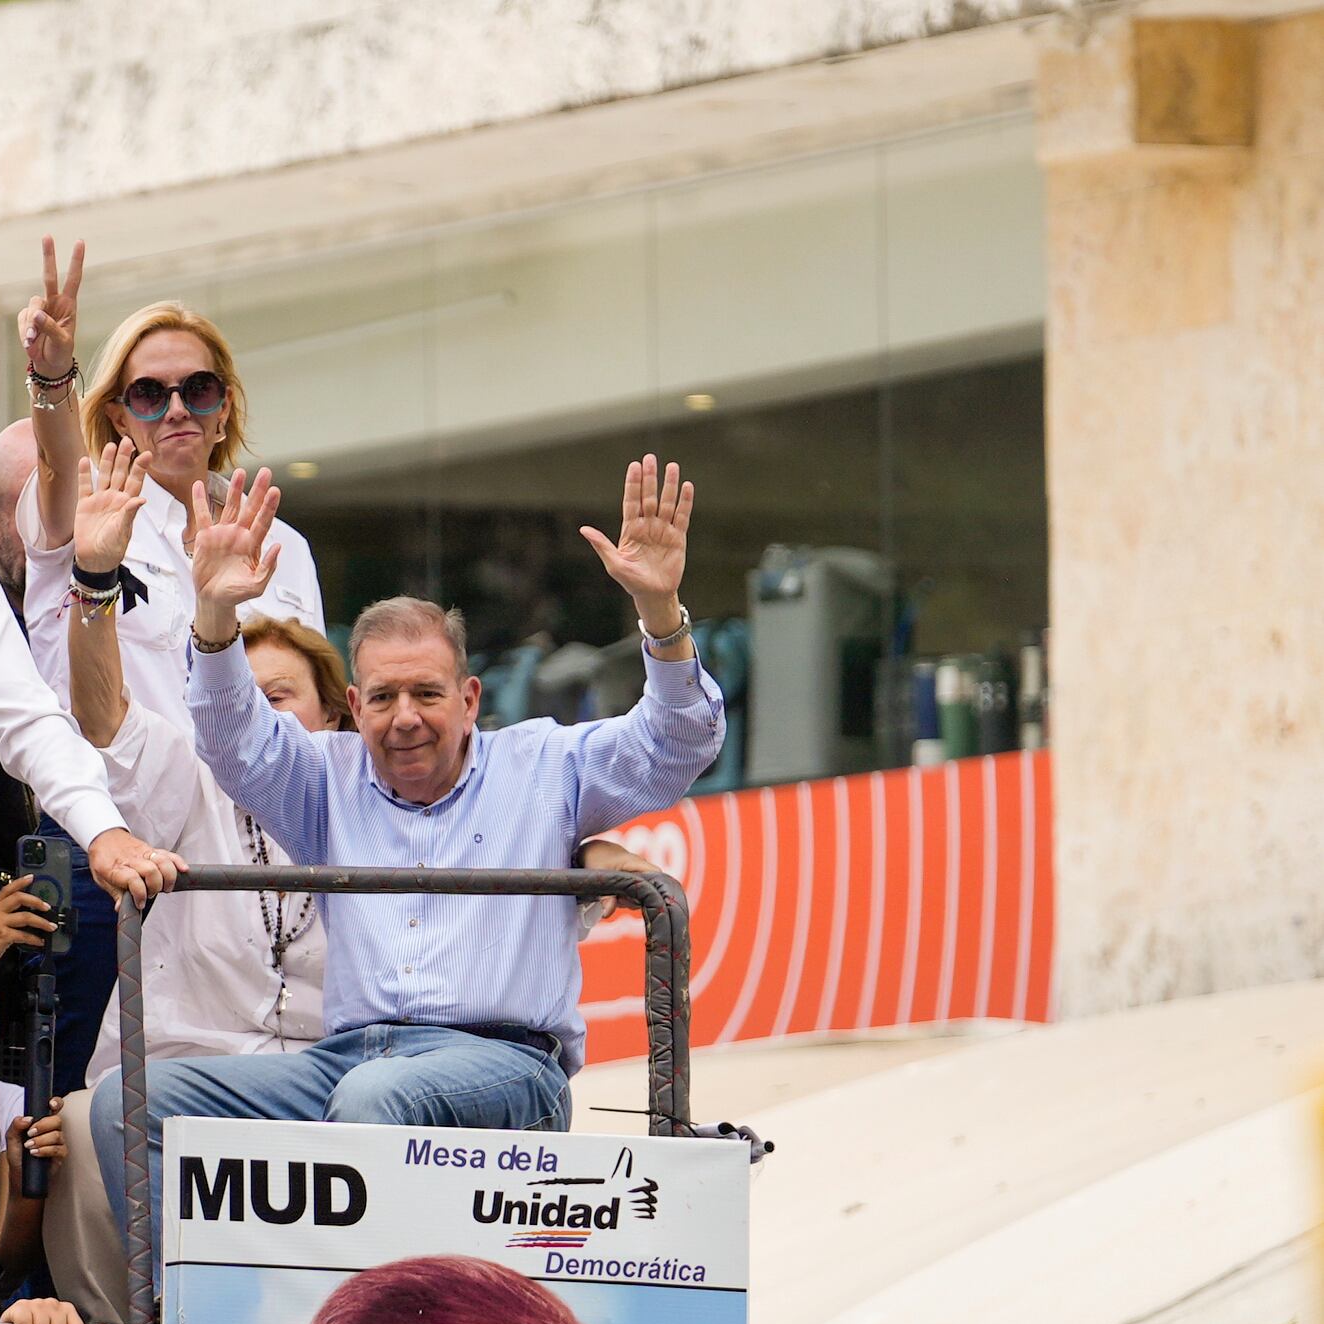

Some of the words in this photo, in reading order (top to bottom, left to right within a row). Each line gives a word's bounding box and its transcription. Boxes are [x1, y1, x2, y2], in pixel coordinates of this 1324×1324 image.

[404, 1138, 487, 1169] Mesa
[497, 1144, 532, 1172] de
[536, 1146, 559, 1173] la
[179, 1156, 368, 1227] MUD
[472, 1189, 621, 1230] Unidad
[544, 1251, 706, 1283] Democrática
